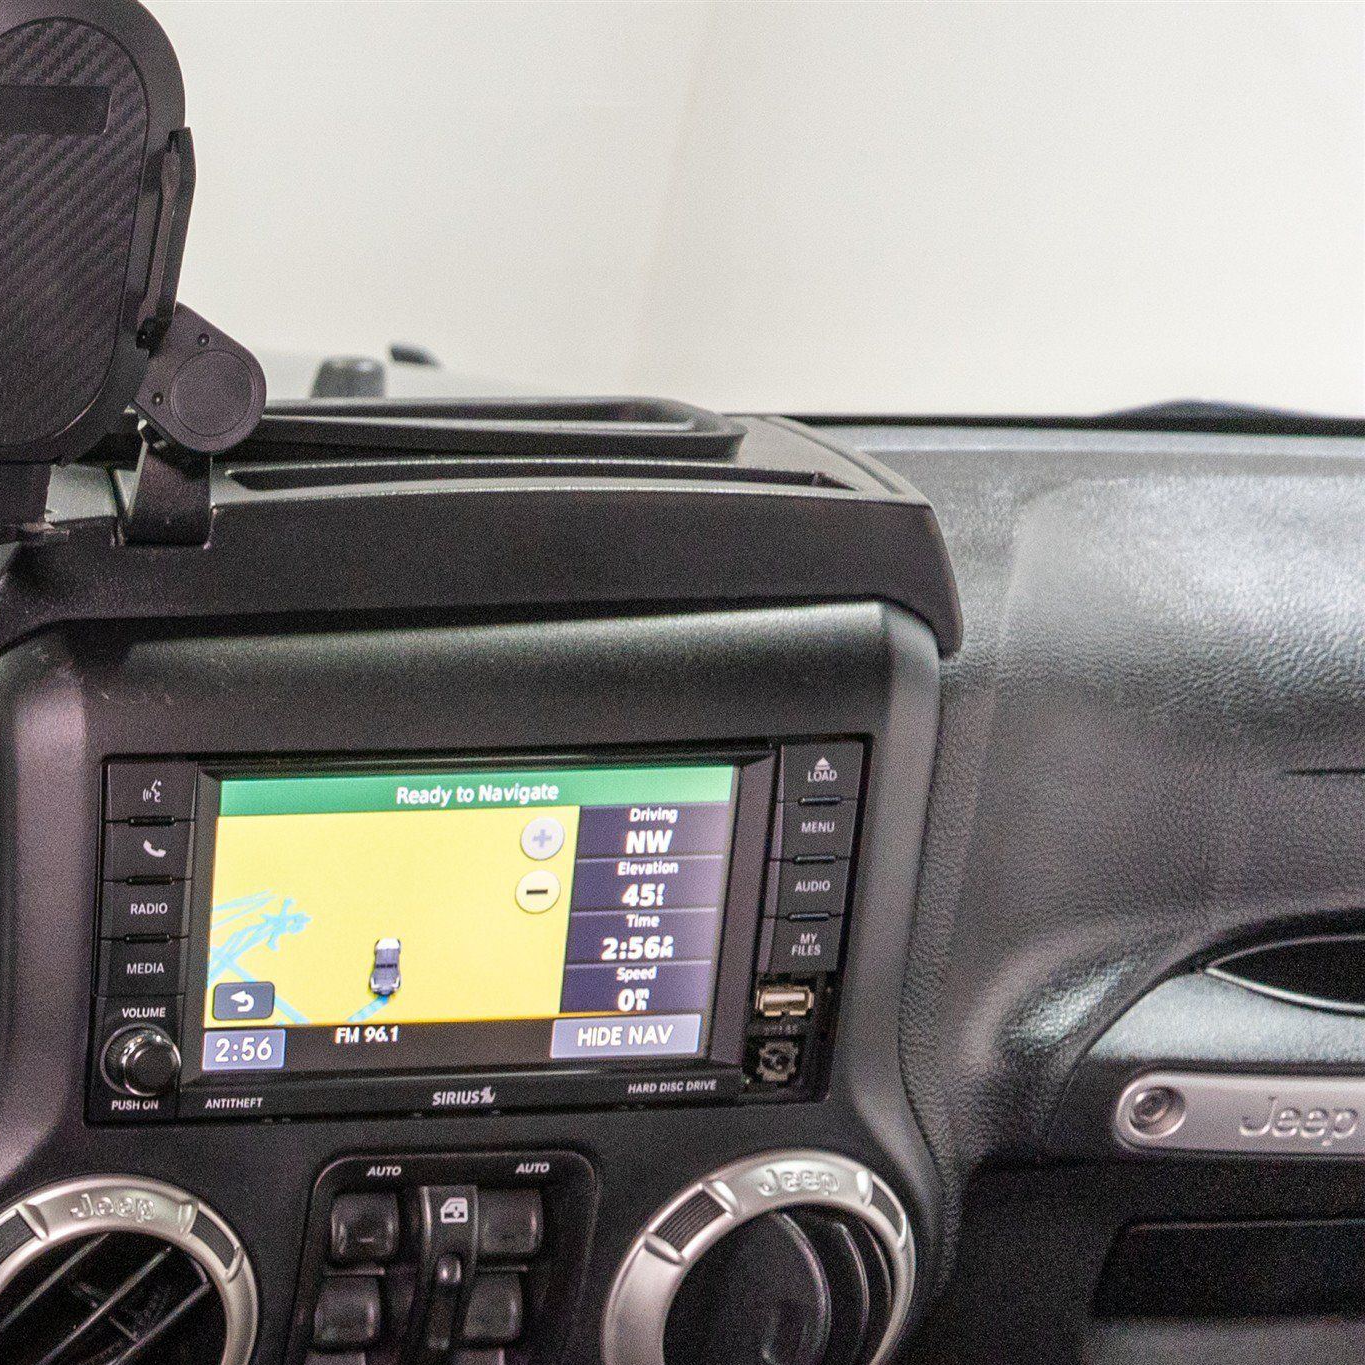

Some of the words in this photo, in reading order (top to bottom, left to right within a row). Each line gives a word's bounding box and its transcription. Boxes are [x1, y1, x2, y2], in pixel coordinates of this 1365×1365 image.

[807, 770, 838, 783] LOAD
[396, 784, 451, 808] Ready
[456, 786, 475, 803] to
[478, 782, 560, 808] Navigate
[629, 807, 678, 824] Driving
[801, 821, 835, 833] MENU
[625, 829, 673, 854] NW
[617, 861, 679, 876] Elevation
[795, 880, 830, 892] AUDIO
[130, 902, 168, 915] RADIO
[625, 913, 660, 928] Time
[800, 934, 818, 944] MY
[791, 944, 821, 956] FILES
[126, 963, 165, 975] MEDIA
[616, 966, 658, 983] Speed
[122, 1007, 167, 1018] VOLUME
[335, 1027, 360, 1044] FM
[364, 1026, 400, 1043] 96.1
[577, 1026, 623, 1047] HIDE
[628, 1024, 674, 1045] NAV
[214, 1037, 273, 1063] 2:56
[627, 1082, 657, 1094] HARD
[659, 1081, 685, 1093] DISC
[686, 1079, 717, 1092] DRIVE
[111, 1100, 140, 1111] PUSH
[142, 1099, 159, 1110] ON
[205, 1097, 263, 1109] ANTITHEFT
[432, 1090, 480, 1106] SIRIUS
[1238, 1096, 1359, 1147] Jeep
[367, 1166, 402, 1177] AUTO
[515, 1162, 550, 1174] AUTO
[756, 1168, 840, 1197] Jeep
[70, 1193, 155, 1223] Jeep
